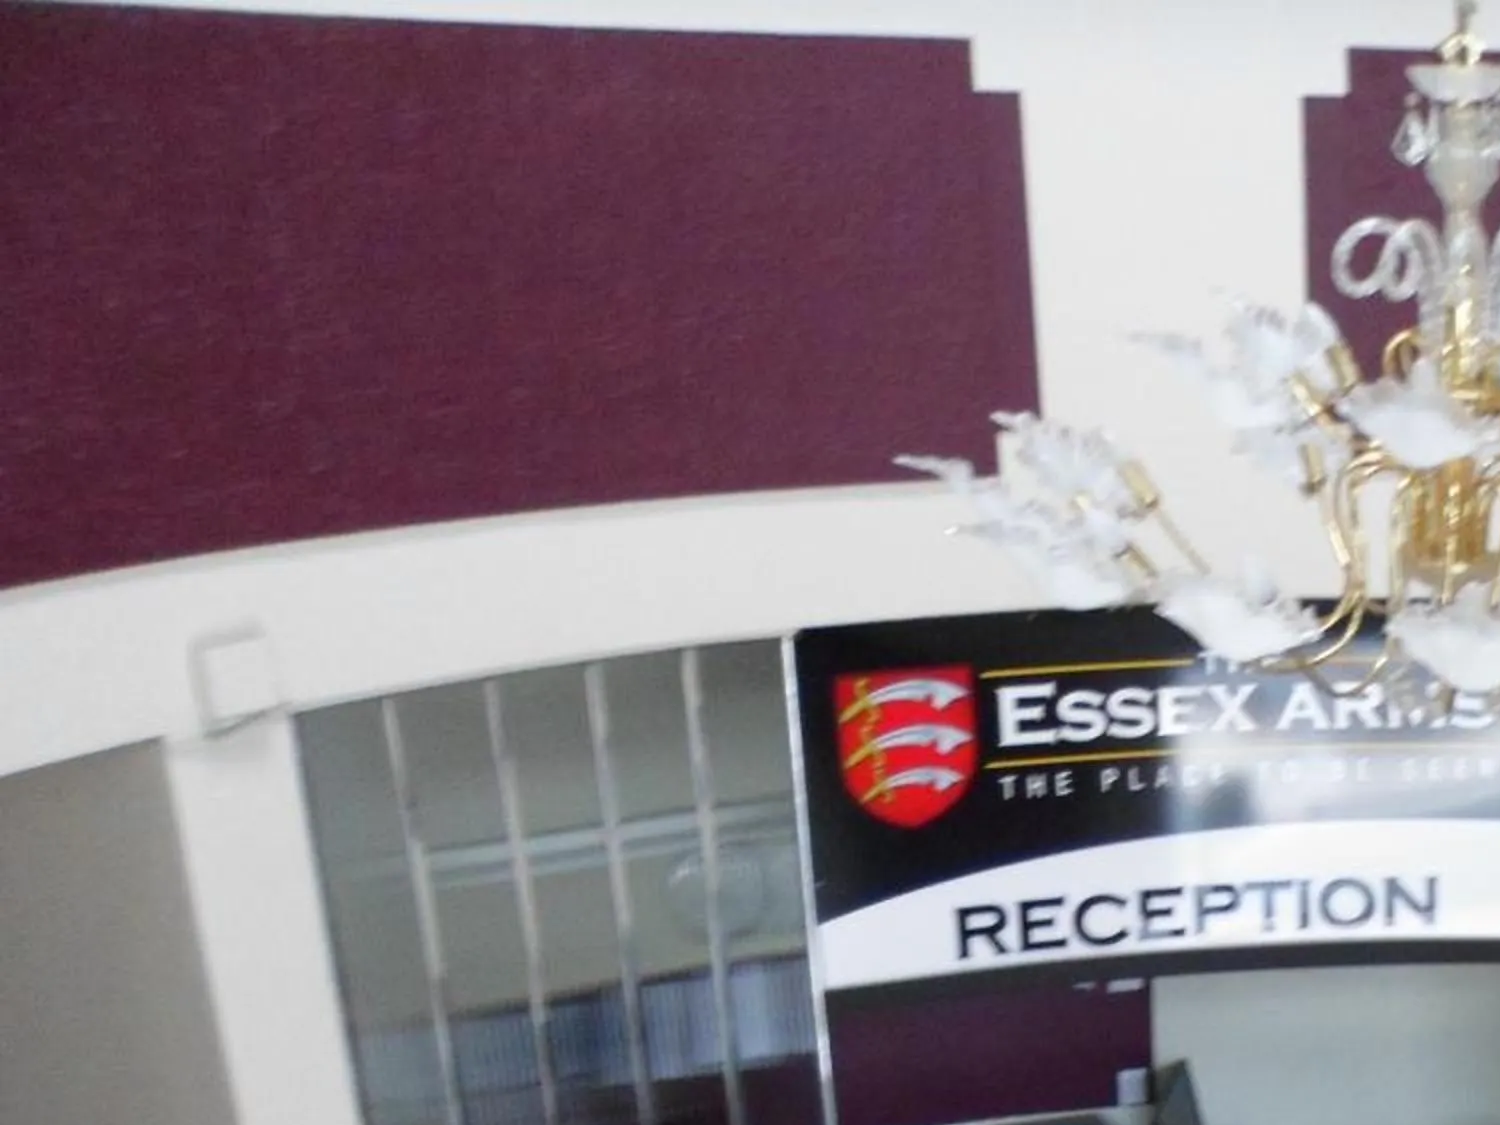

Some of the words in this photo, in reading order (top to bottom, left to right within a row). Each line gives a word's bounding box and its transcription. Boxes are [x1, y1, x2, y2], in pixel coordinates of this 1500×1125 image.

[995, 681, 1259, 747] ESSEX
[998, 769, 1075, 800] THE
[954, 877, 1441, 961] RECEPTION
